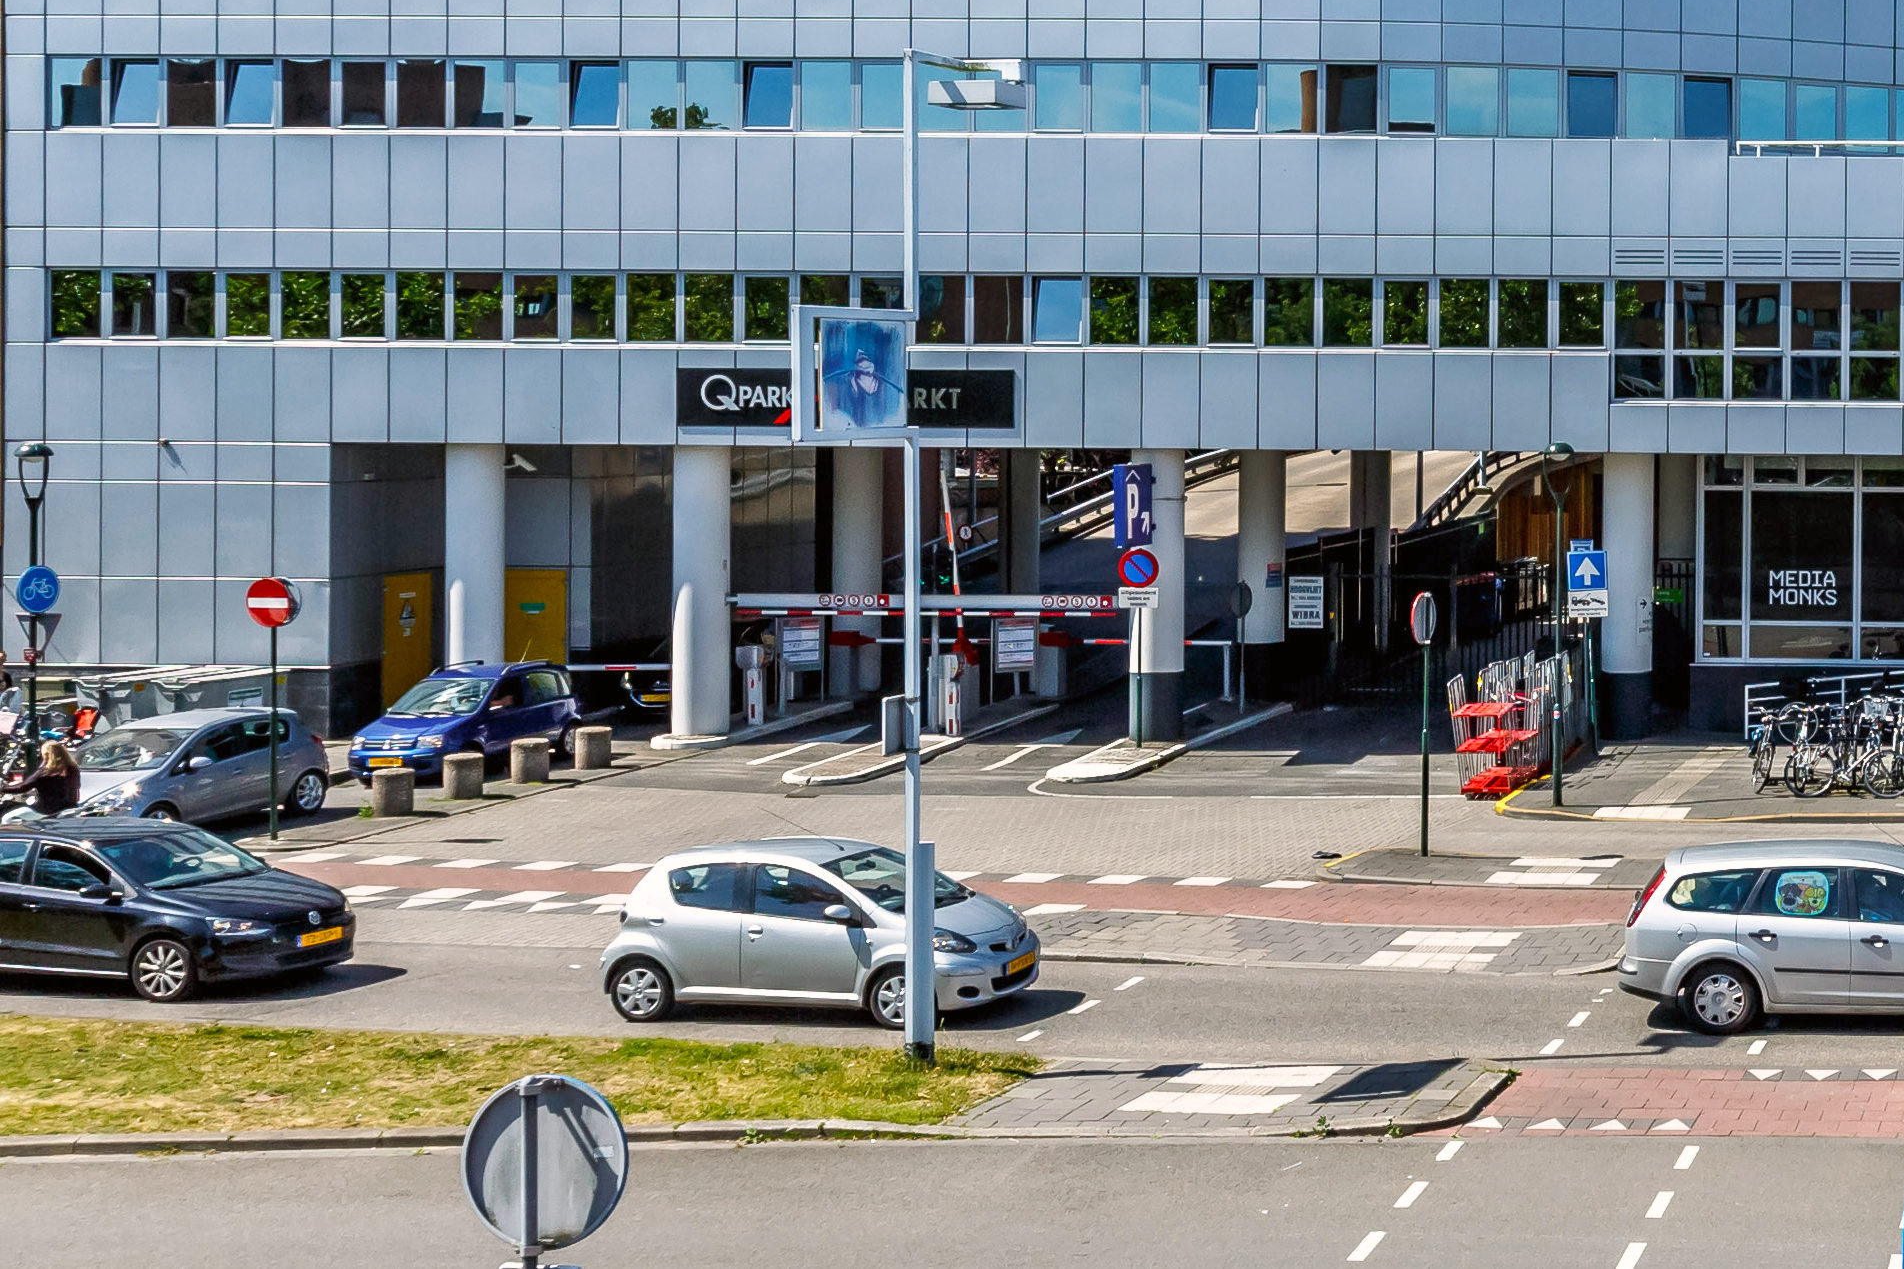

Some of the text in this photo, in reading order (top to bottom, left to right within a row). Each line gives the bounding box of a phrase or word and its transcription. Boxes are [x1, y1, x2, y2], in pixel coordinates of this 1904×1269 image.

[1769, 570, 1836, 587] MEDIA
[1769, 589, 1837, 605] MONKS
[1292, 611, 1320, 619] WIBRA
